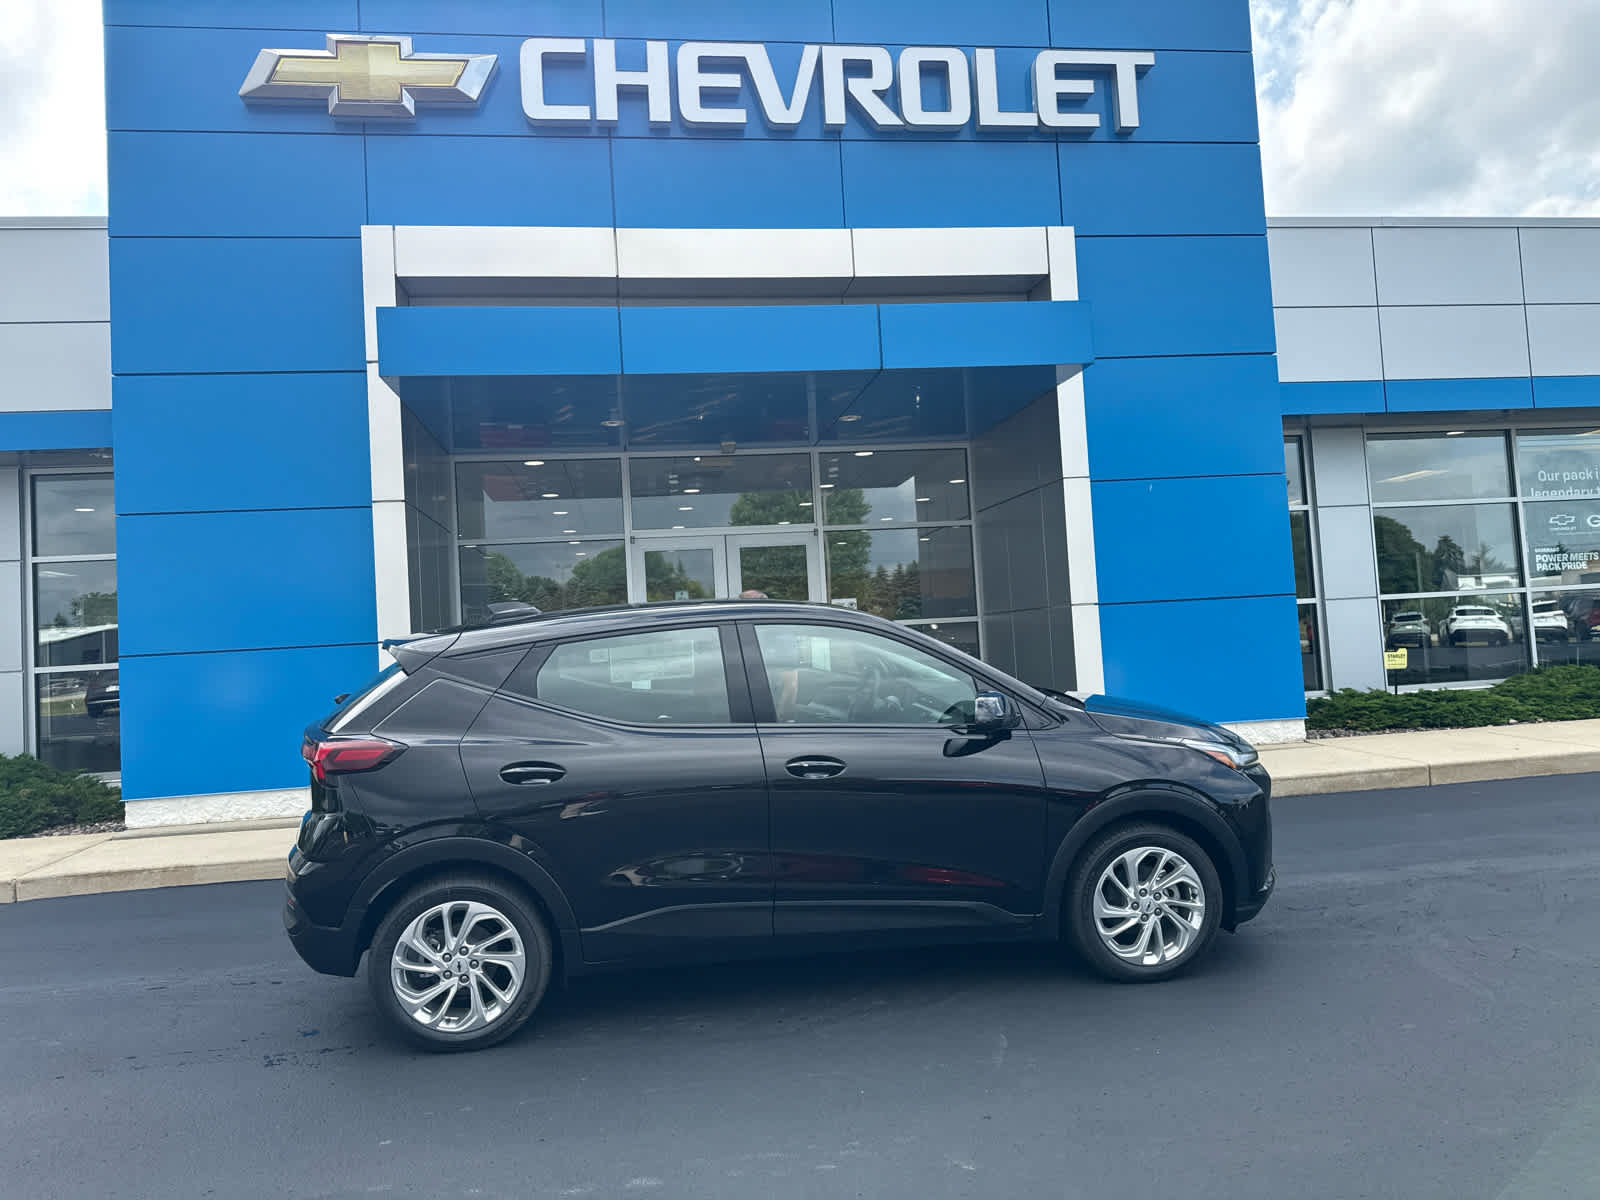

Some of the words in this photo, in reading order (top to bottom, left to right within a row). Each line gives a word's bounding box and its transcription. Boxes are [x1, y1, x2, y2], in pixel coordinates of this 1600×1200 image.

[520, 37, 1156, 132] CHEVROLET
[1537, 470, 1560, 481] Our
[1563, 468, 1593, 484] pack
[1535, 553, 1569, 563] POWER
[1570, 552, 1599, 561] MEETS
[1536, 562, 1561, 571] PACK
[1561, 560, 1588, 570] PRIDE
